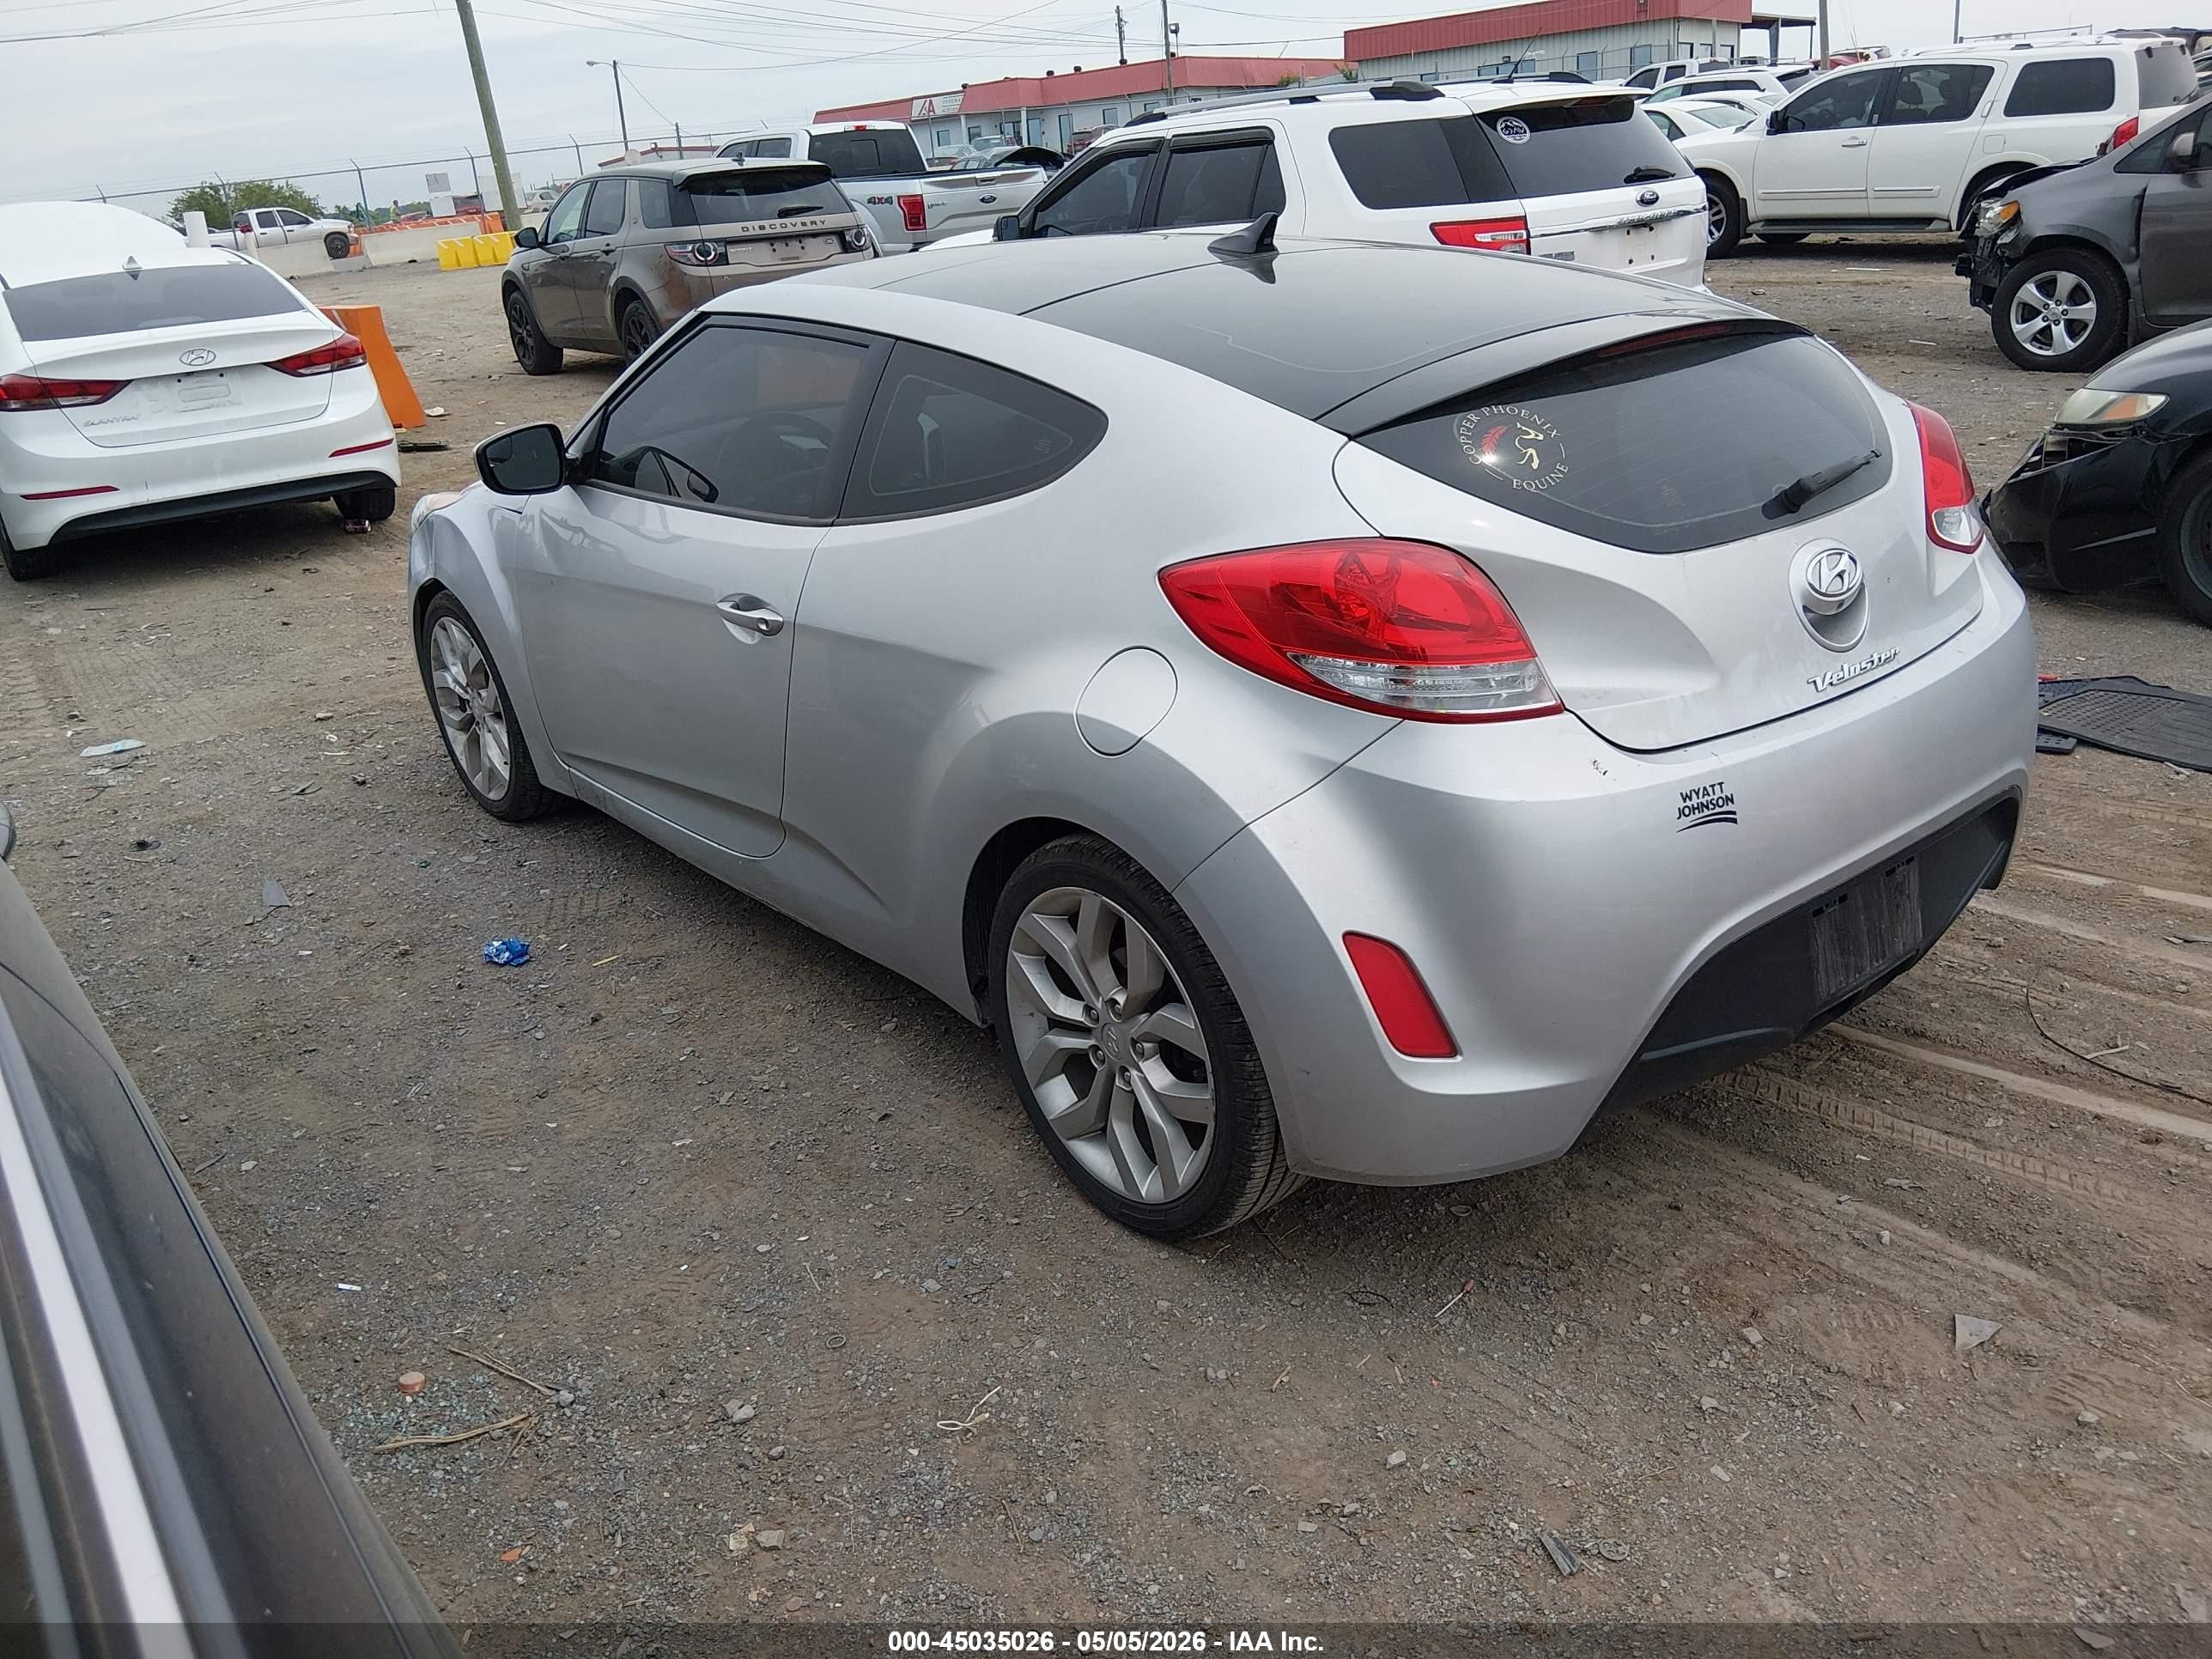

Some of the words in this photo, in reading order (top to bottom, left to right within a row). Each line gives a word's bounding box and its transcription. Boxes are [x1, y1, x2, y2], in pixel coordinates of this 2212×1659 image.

[741, 219, 826, 233] DISCOVERY
[1460, 413, 1481, 465] COPPER
[1480, 405, 1561, 438] PHOENIX
[1512, 463, 1568, 492] EQUINE
[1807, 646, 1900, 692] Veloster
[1676, 793, 1735, 820] JOHNSON
[1680, 781, 1724, 804] WYATT
